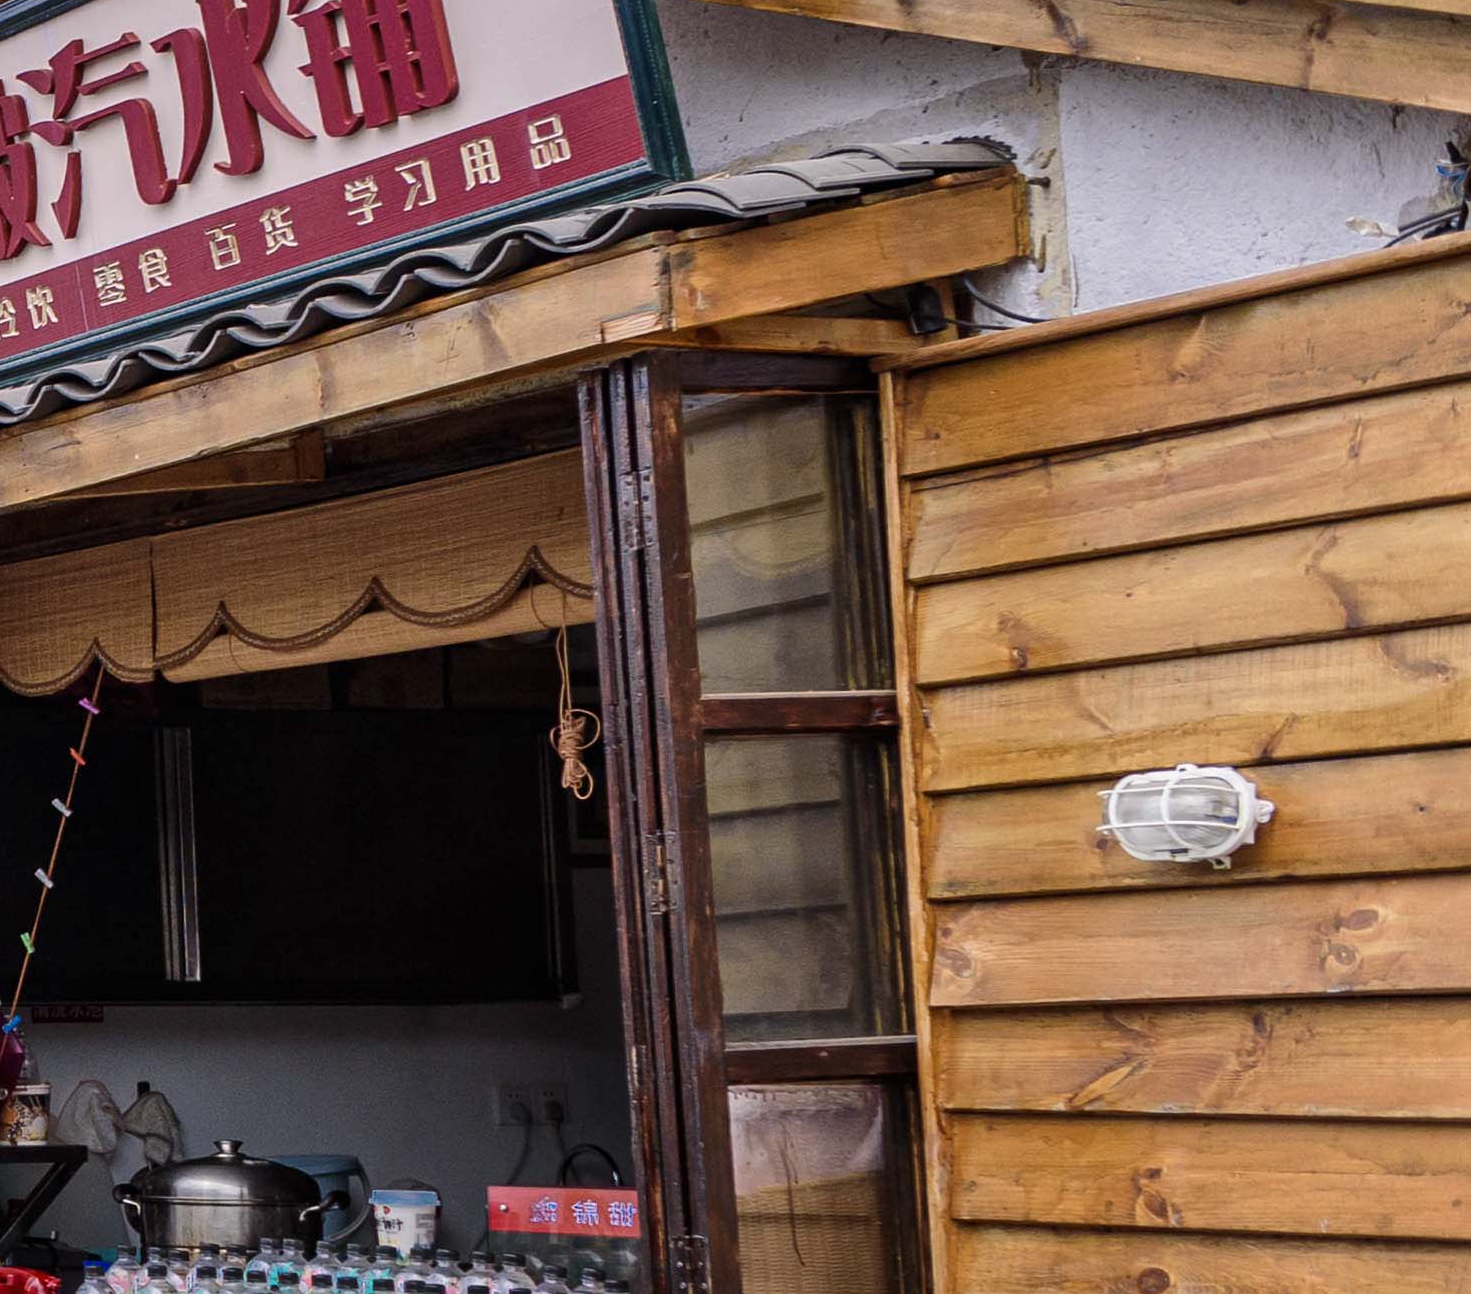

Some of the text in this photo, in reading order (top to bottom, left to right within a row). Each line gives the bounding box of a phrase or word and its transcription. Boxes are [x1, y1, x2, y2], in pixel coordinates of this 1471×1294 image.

[93, 249, 172, 307] 零食
[205, 206, 299, 271] 百货
[344, 114, 571, 226] 学习用品
